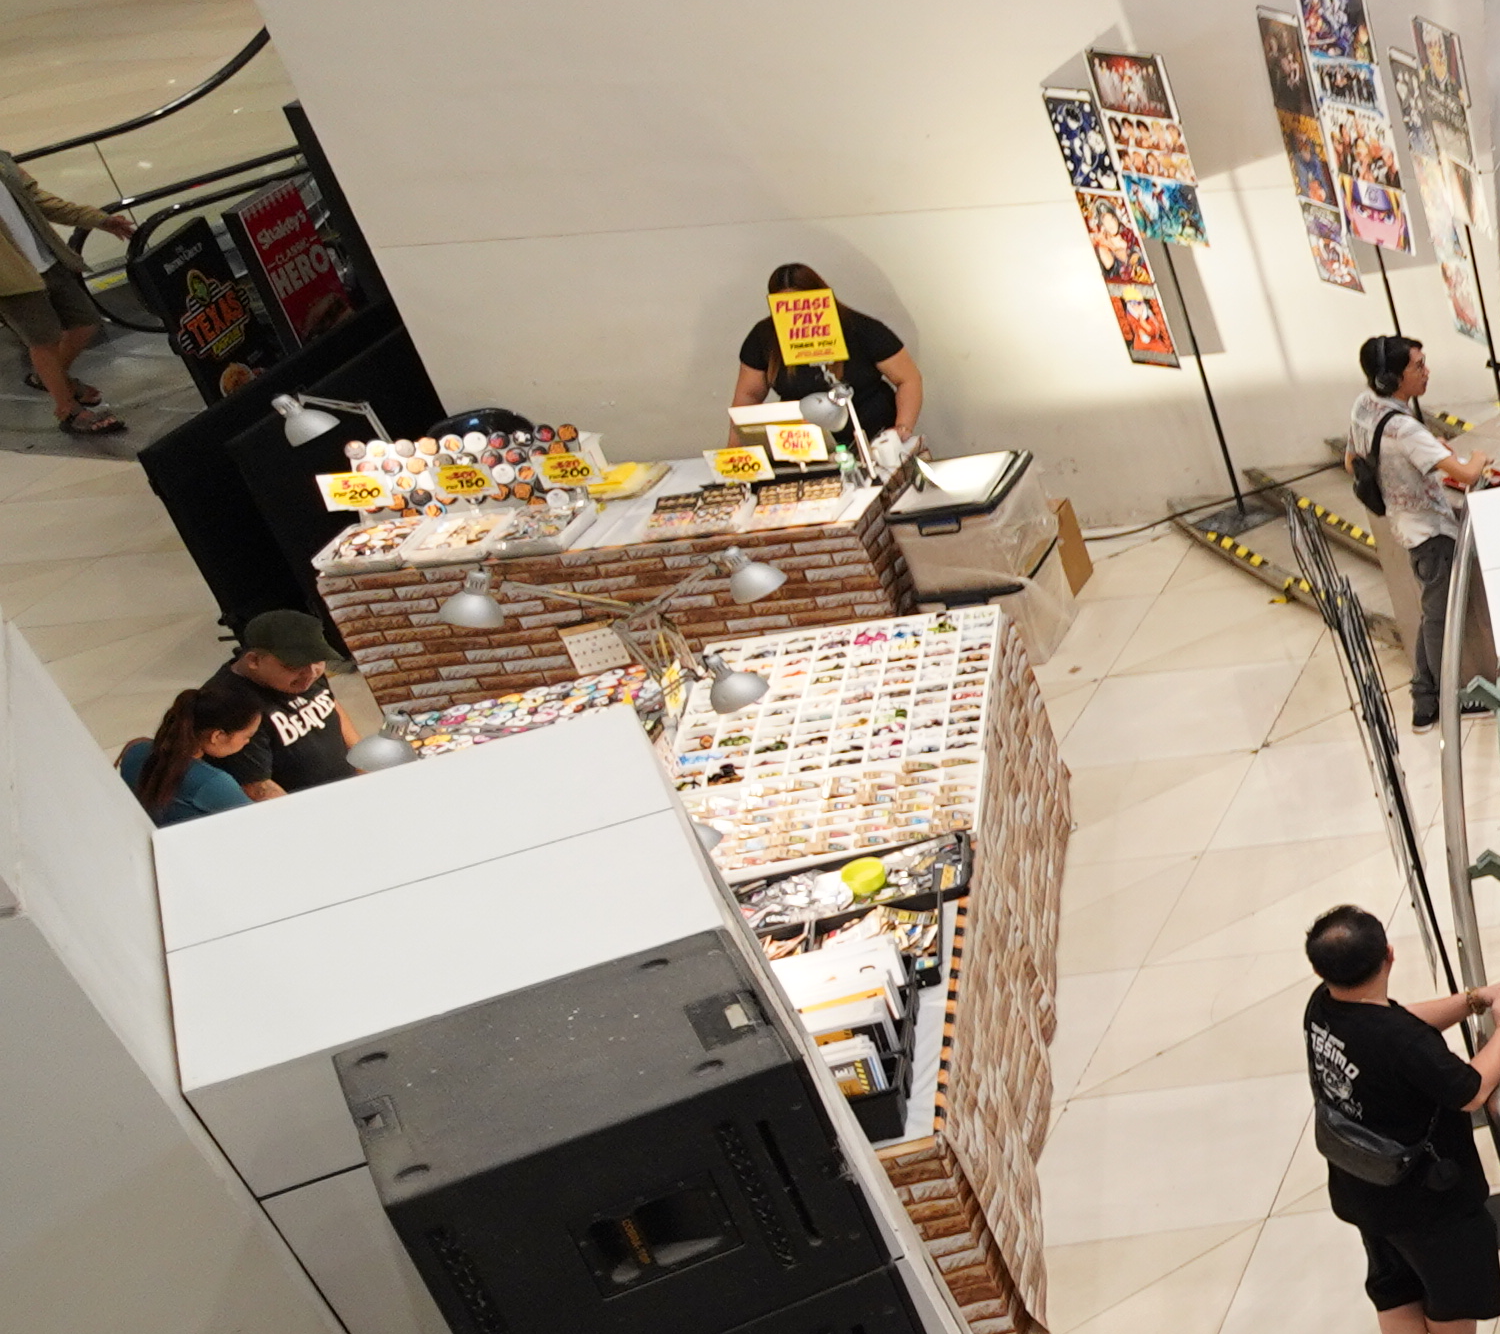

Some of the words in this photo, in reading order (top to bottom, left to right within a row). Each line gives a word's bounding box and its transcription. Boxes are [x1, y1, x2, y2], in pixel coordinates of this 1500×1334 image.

[256, 212, 309, 251] Shakey's
[269, 243, 331, 300] HERO
[775, 296, 831, 313] PLEASE
[186, 291, 244, 348] TEXAS
[792, 311, 824, 326] PAY
[789, 324, 831, 341] HERE
[790, 341, 814, 350] THANK
[817, 338, 837, 348] YOU!
[780, 430, 810, 440] CASH
[783, 439, 812, 451] ONLY
